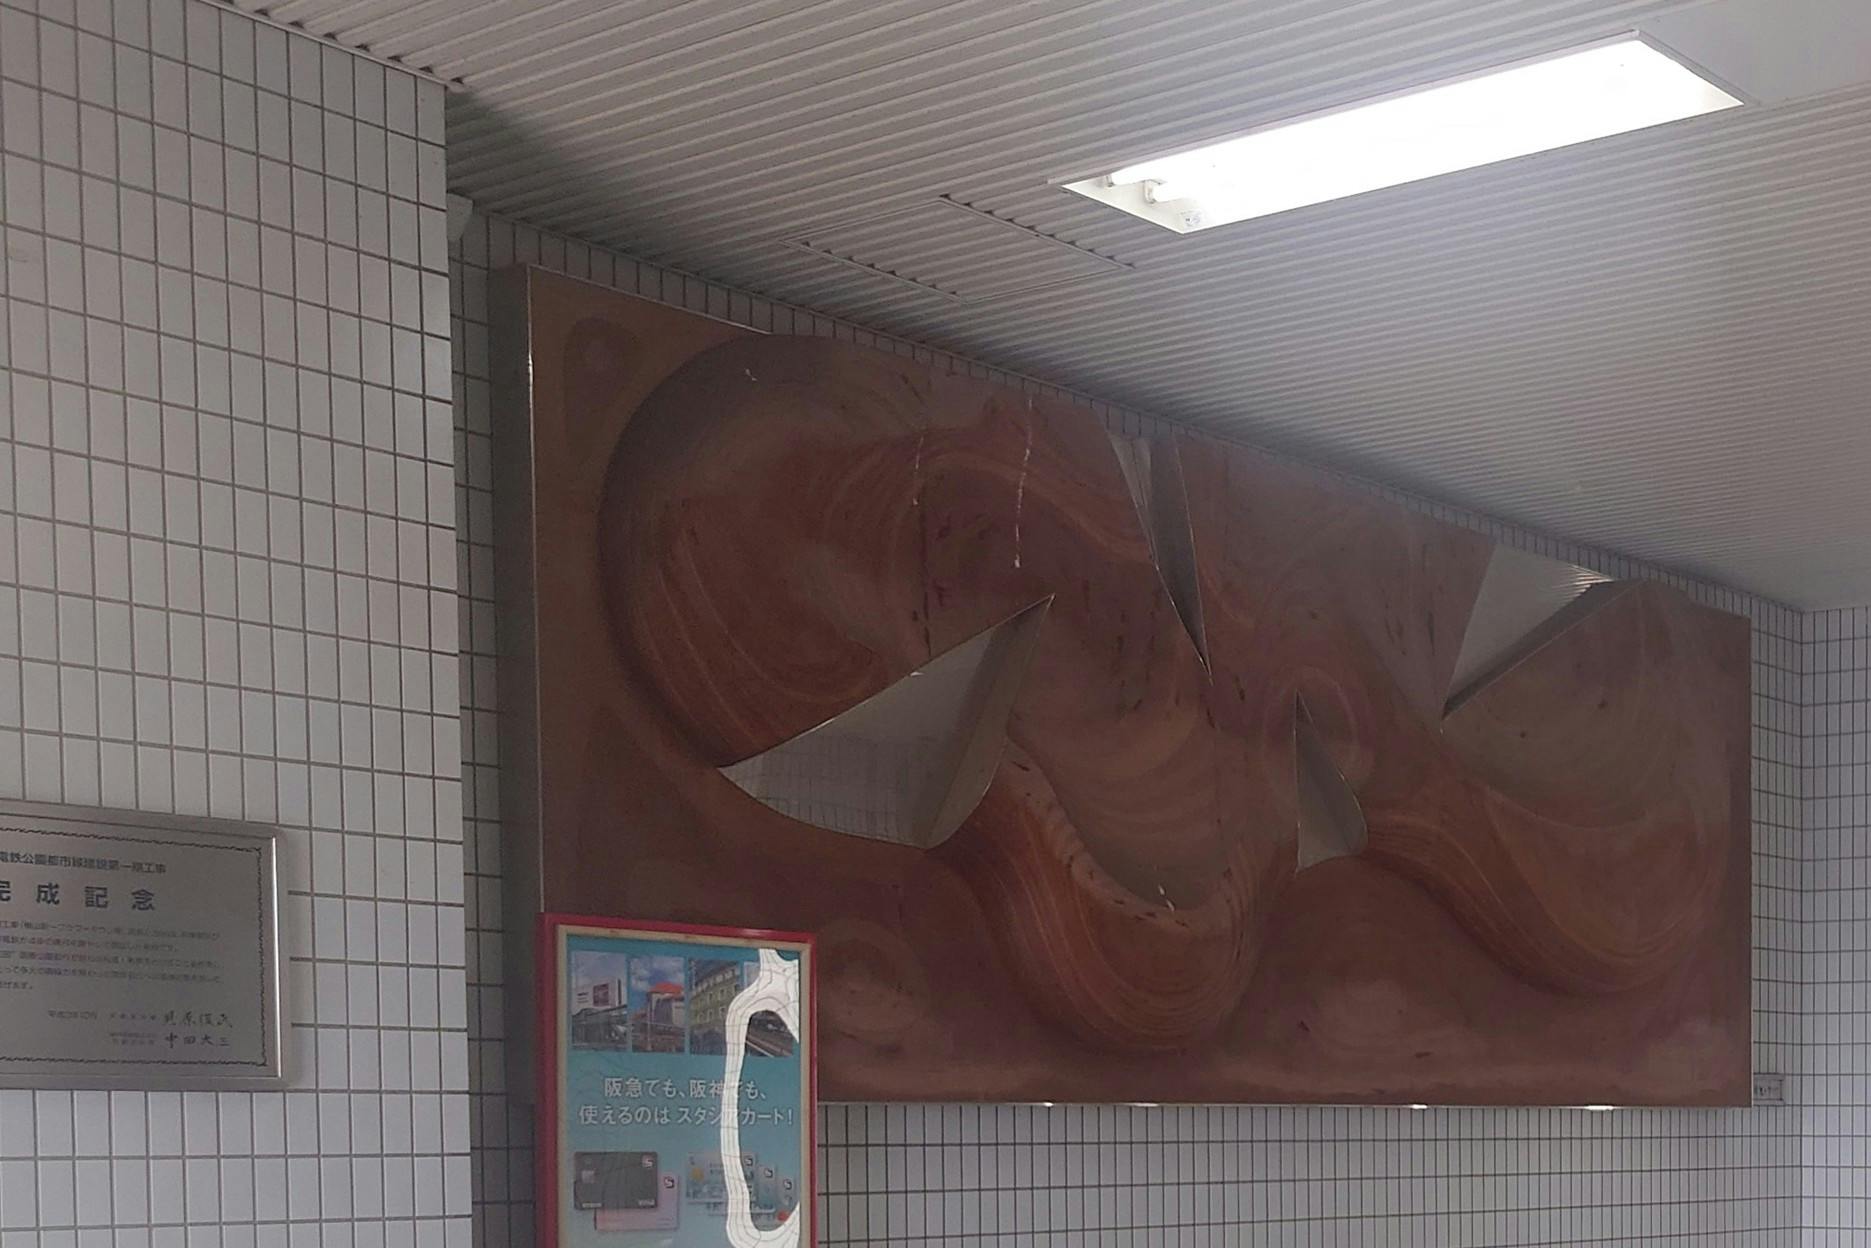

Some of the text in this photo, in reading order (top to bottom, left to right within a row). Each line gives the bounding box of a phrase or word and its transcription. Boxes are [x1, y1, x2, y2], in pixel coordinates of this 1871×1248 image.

[578, 1104, 670, 1126] 使えるのは
